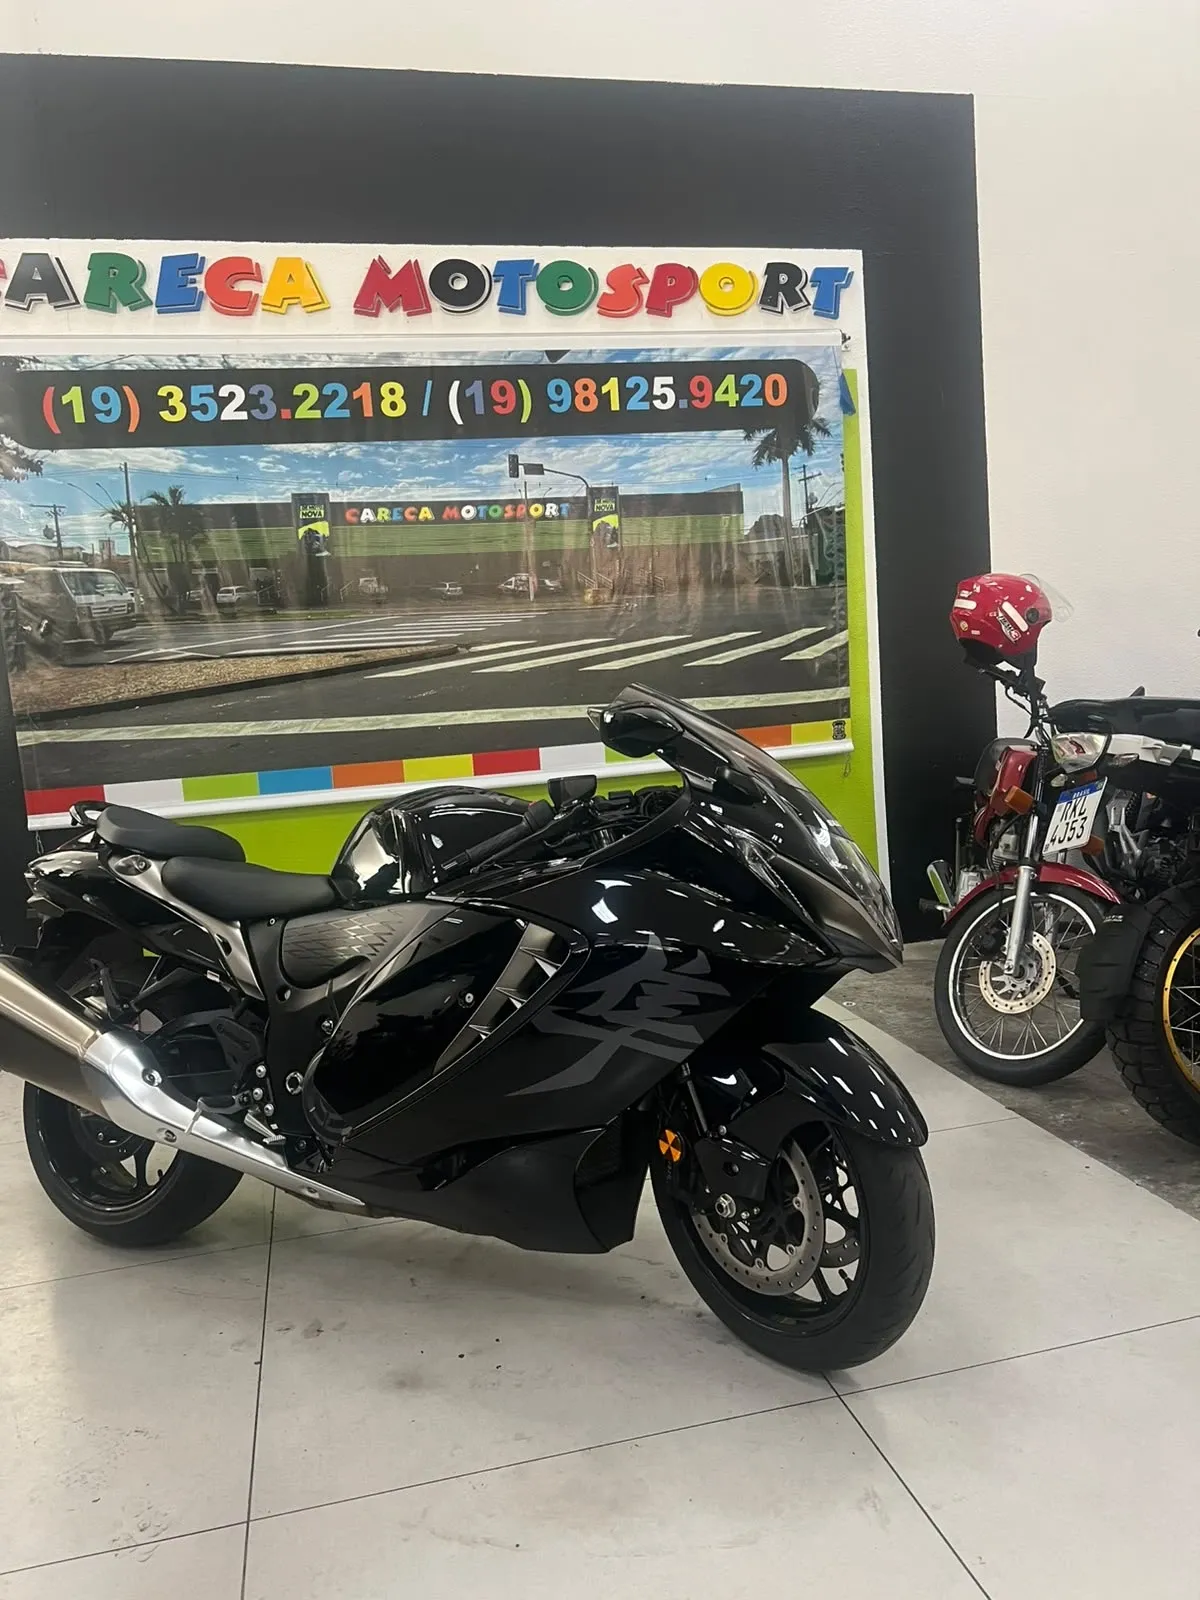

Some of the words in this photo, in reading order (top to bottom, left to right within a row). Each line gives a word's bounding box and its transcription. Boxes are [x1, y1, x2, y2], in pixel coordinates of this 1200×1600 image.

[0, 252, 331, 316] ARECA
[353, 254, 854, 320] MOTOSPORT
[42, 385, 141, 434] (19)
[156, 381, 407, 423] 3523.2218
[421, 380, 433, 417] /
[448, 379, 532, 425] (19)
[547, 373, 788, 415] 98125.9420
[302, 510, 322, 518] NOVA
[345, 506, 435, 524] CARECA
[442, 502, 571, 521] MOTOSPORT
[1050, 816, 1087, 846] 4J53
